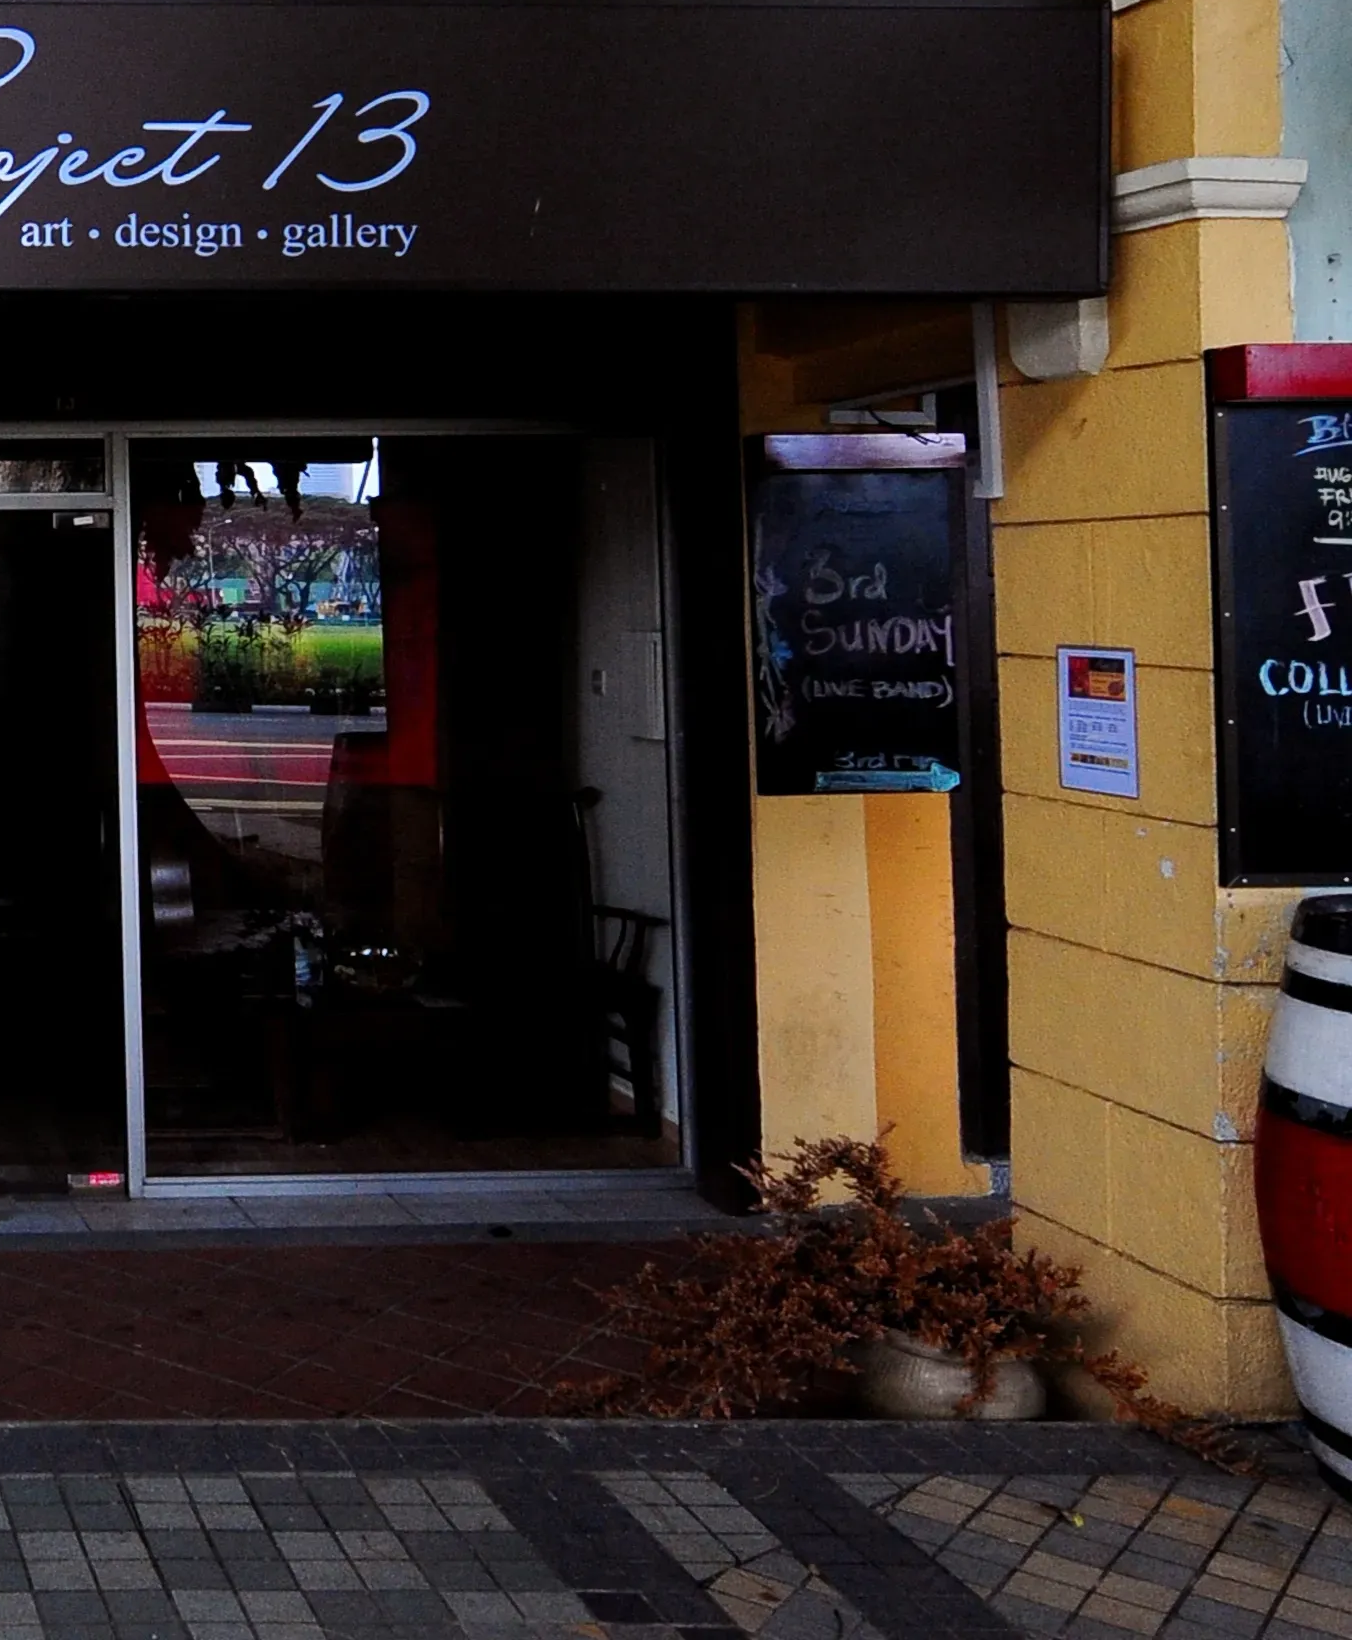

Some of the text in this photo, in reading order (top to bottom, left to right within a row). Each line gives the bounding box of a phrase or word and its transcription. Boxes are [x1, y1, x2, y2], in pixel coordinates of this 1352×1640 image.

[262, 90, 431, 192] 13
[20, 213, 419, 257] art design gallery
[1297, 412, 1352, 444] B
[805, 549, 888, 604] 3rd
